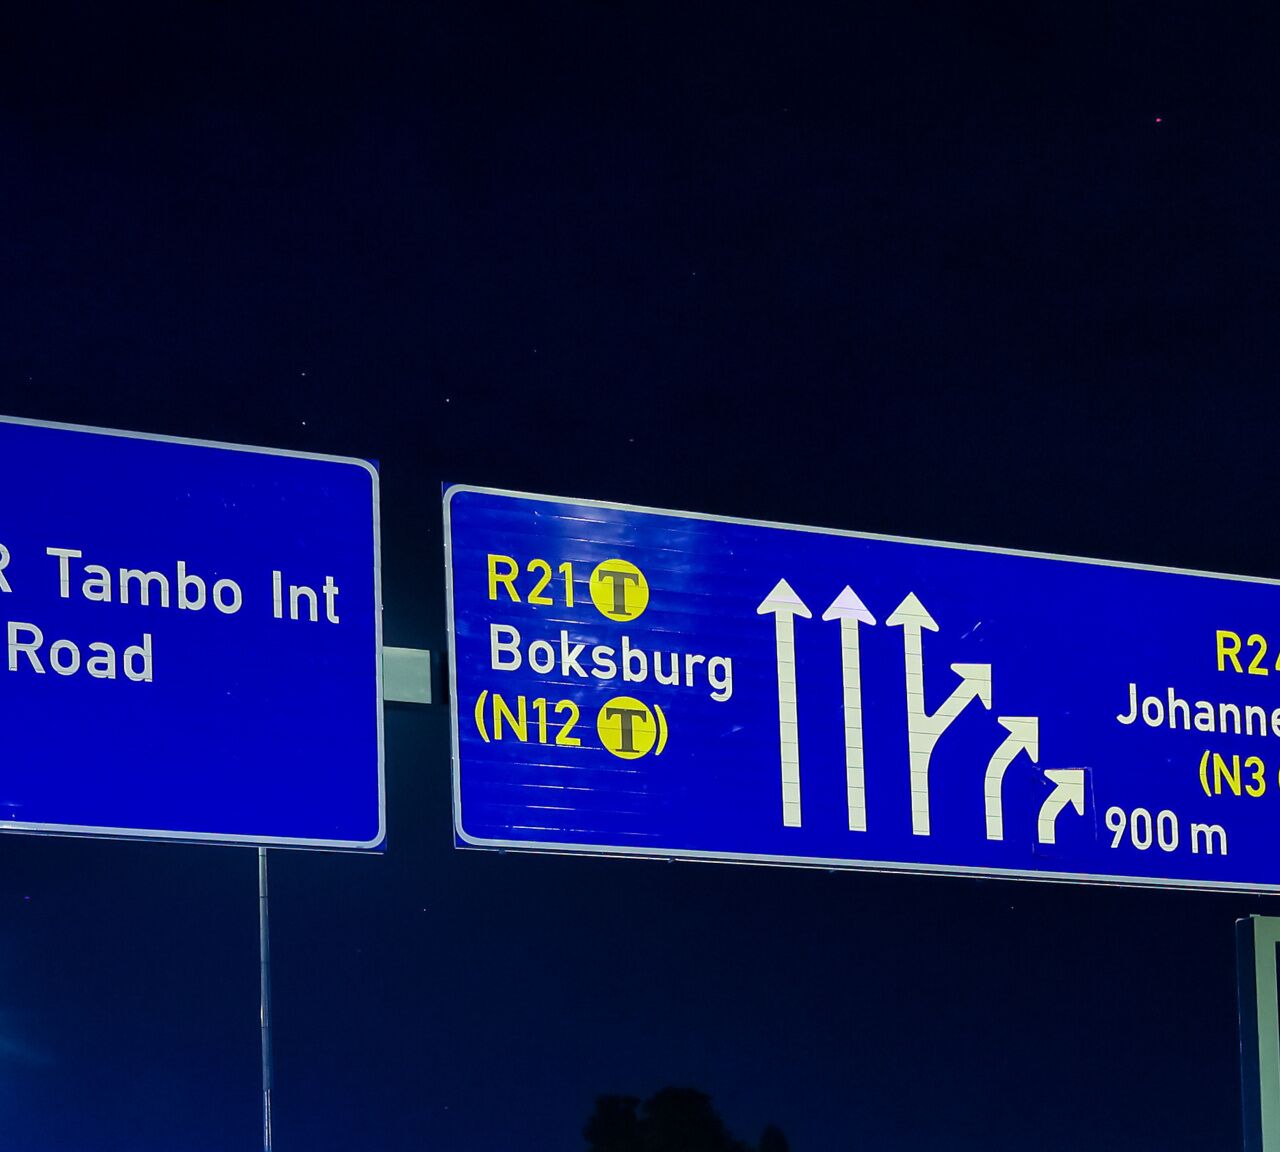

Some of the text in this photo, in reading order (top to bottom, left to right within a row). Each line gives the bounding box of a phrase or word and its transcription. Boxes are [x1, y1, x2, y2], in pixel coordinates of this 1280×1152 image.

[46, 546, 243, 615] Tambo
[272, 570, 340, 624] Int
[486, 553, 575, 608] R21
[7, 620, 154, 683] Road
[489, 622, 733, 702] Boksburg
[1104, 806, 1228, 856] 900 m
